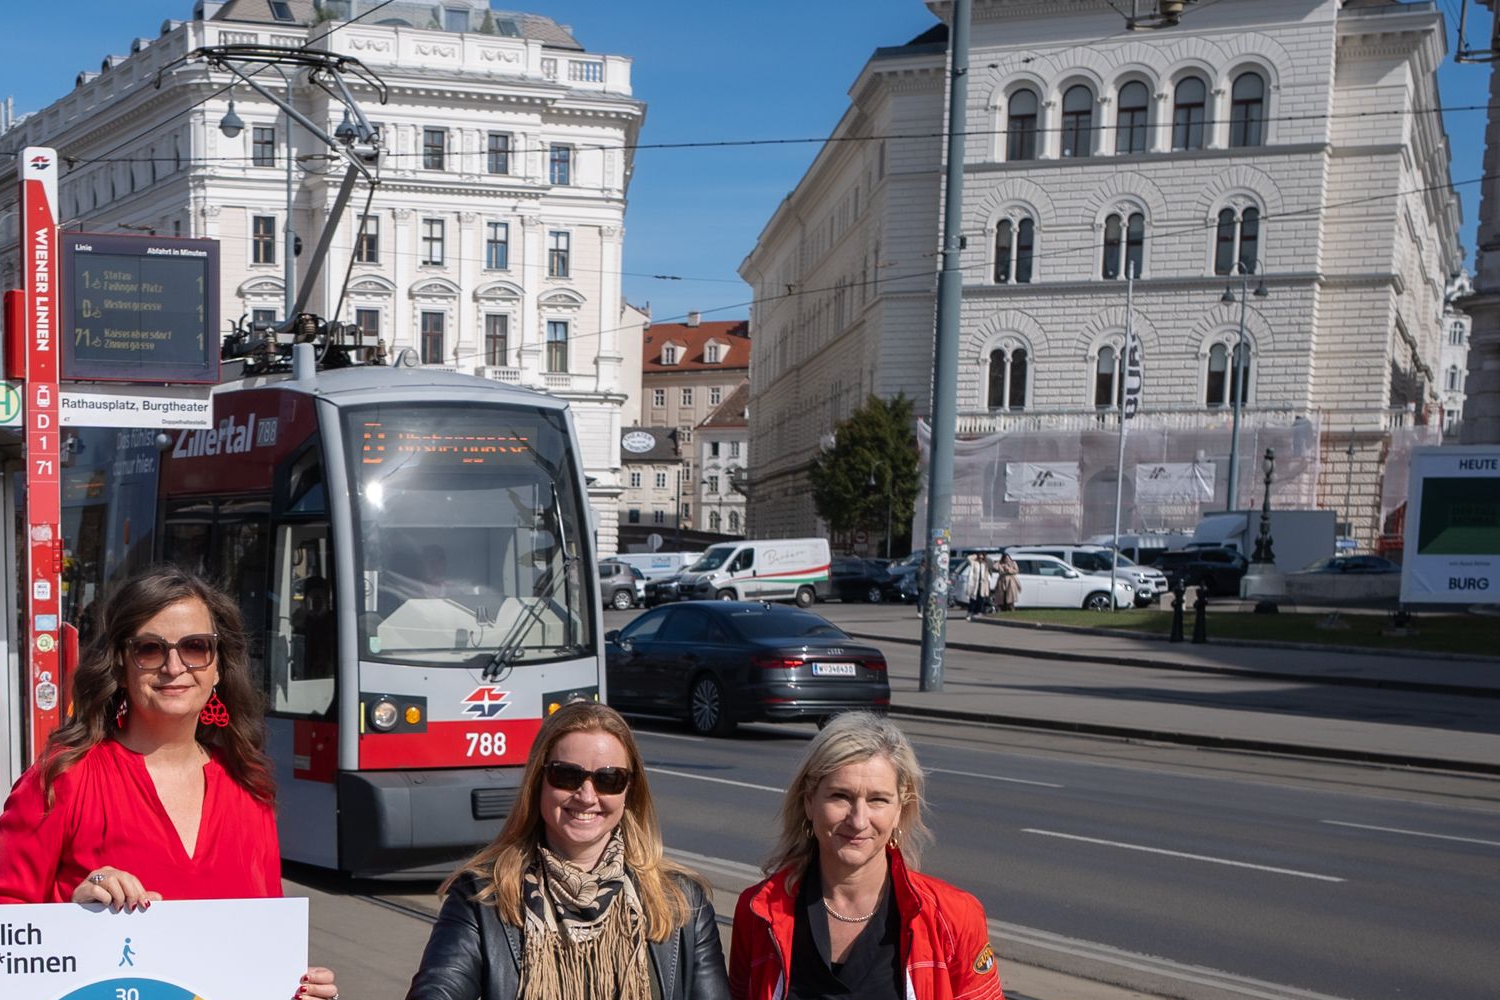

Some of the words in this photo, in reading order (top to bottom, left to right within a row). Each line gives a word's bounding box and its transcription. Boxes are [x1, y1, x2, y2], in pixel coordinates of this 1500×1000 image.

[147, 247, 171, 255] Abfahrt
[35, 227, 48, 293] WIENER
[82, 271, 89, 288] 1
[36, 297, 50, 351] LINIEN
[75, 328, 90, 347] 71
[62, 398, 139, 412] Rathausplatz,
[143, 400, 209, 413] Burgtheater
[37, 415, 50, 429] D
[258, 419, 277, 445] 788
[40, 436, 47, 449] 1
[36, 461, 52, 475] 71
[1459, 459, 1498, 470] HEUTE
[1449, 577, 1489, 590] BURG
[465, 732, 506, 757] 788
